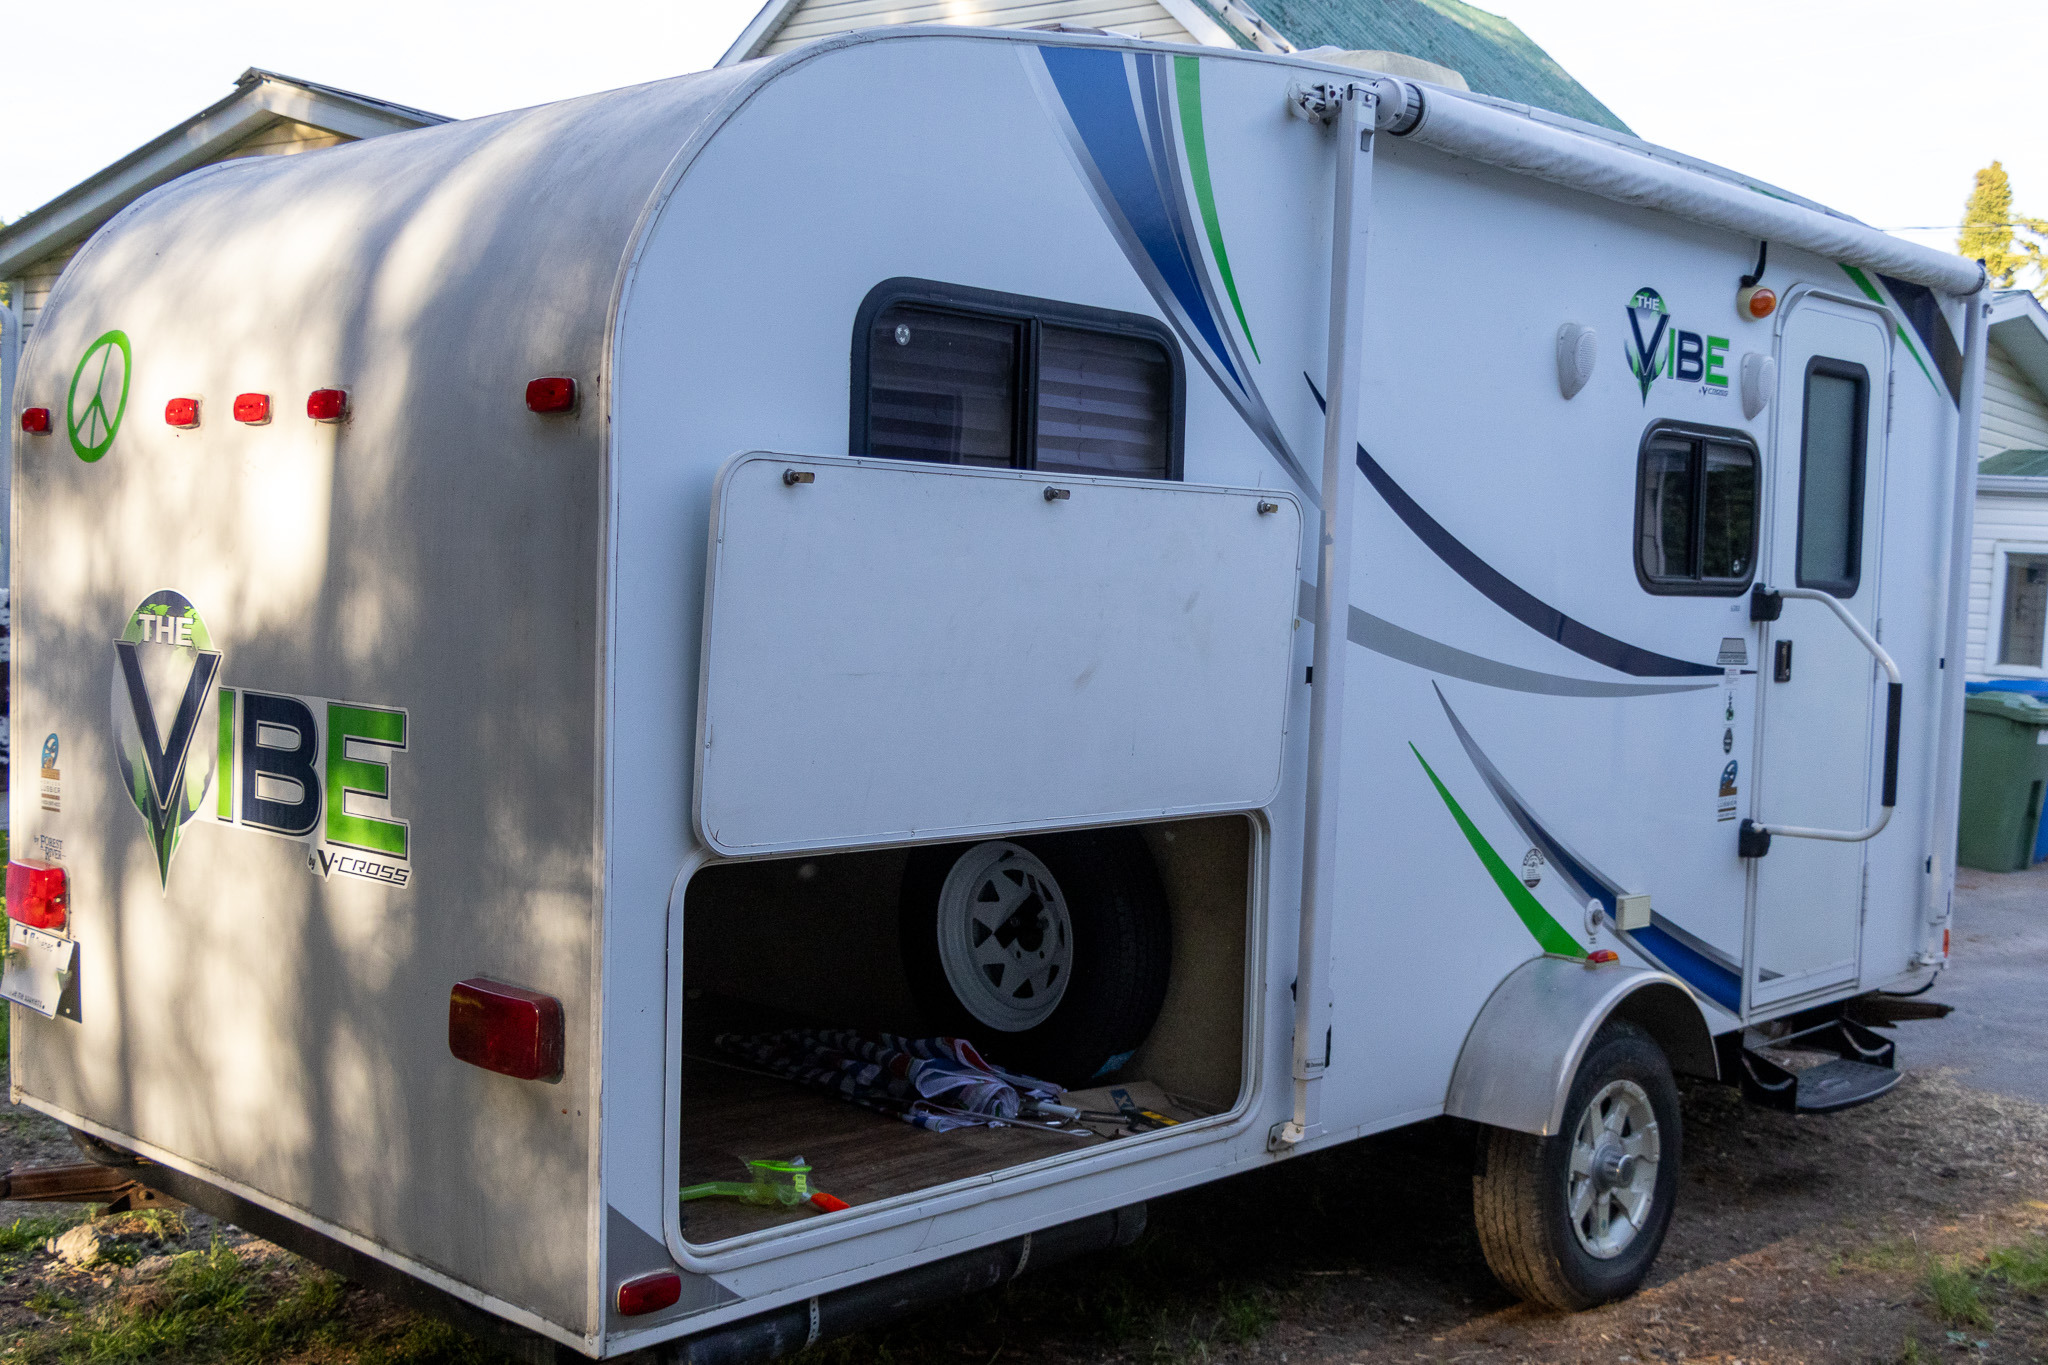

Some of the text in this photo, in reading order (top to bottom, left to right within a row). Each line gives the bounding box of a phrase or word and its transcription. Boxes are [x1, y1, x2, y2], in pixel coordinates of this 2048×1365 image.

[1635, 295, 1660, 311] THE
[1625, 305, 1730, 390] VIBE
[138, 613, 193, 646] THE
[113, 638, 409, 864] VIBE
[317, 849, 410, 884] V-CROSS
